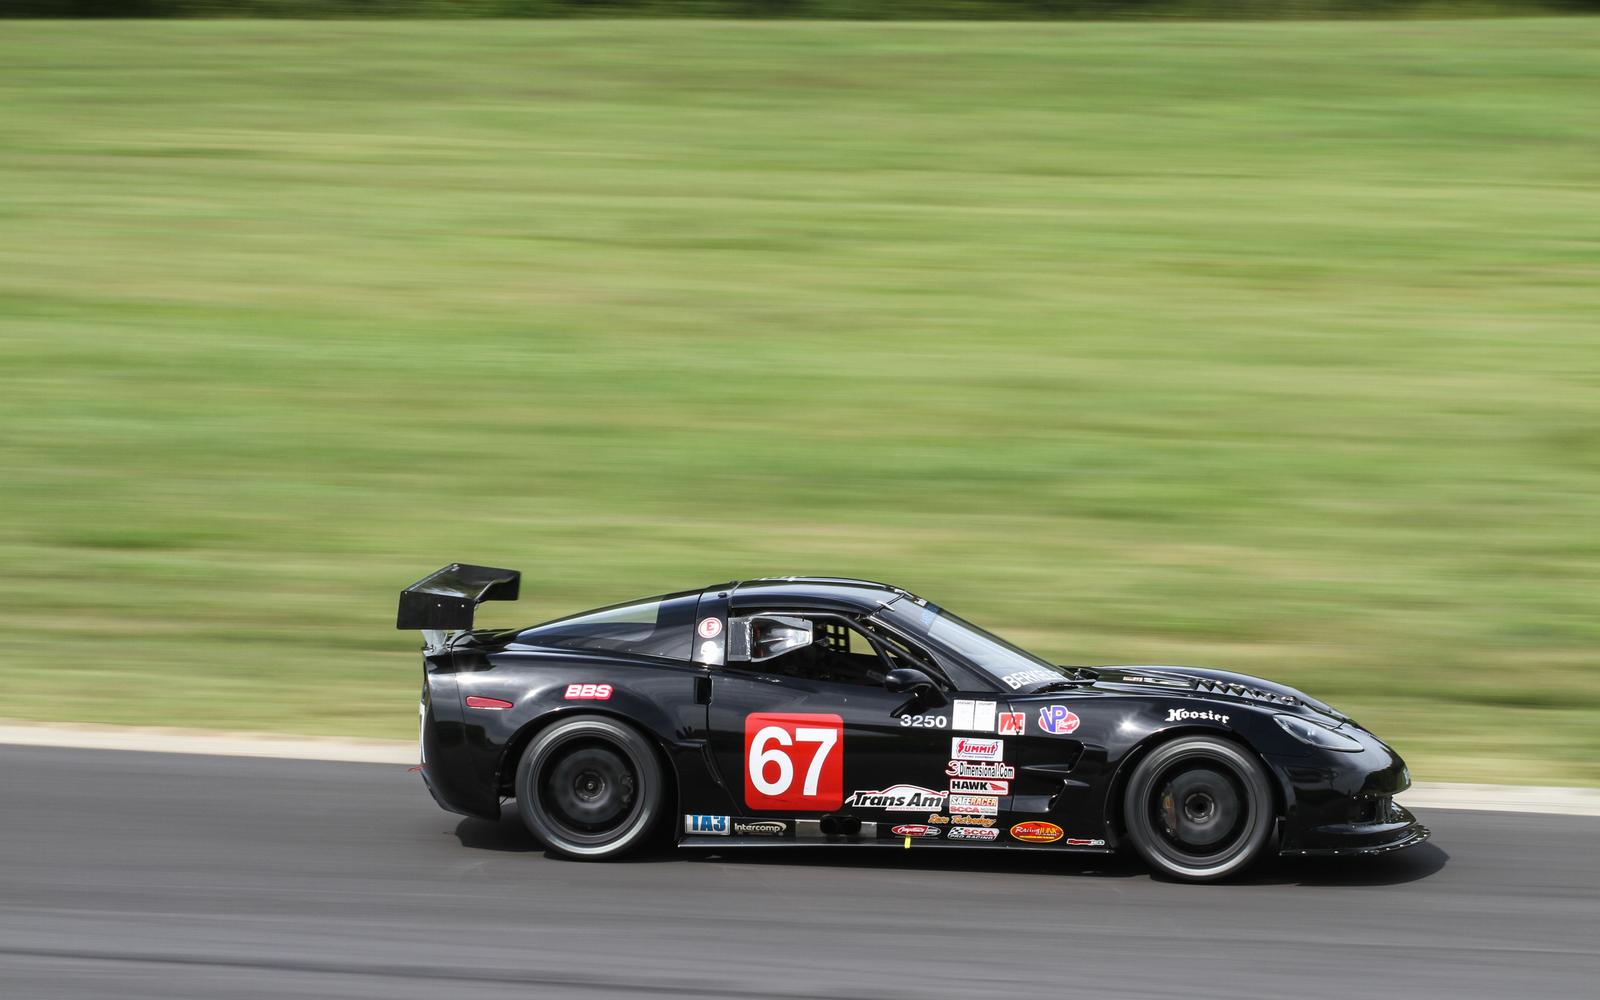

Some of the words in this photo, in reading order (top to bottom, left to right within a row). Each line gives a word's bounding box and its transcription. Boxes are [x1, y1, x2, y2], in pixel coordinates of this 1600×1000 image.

[565, 684, 612, 698] BBS
[900, 715, 947, 728] 3250
[1040, 705, 1067, 733] VP
[1165, 708, 1230, 723] Hoosier
[749, 726, 838, 796] 67
[952, 781, 989, 790] HAWK
[854, 791, 905, 807] Trans
[906, 792, 941, 807] Am
[734, 822, 781, 833] Intercomp
